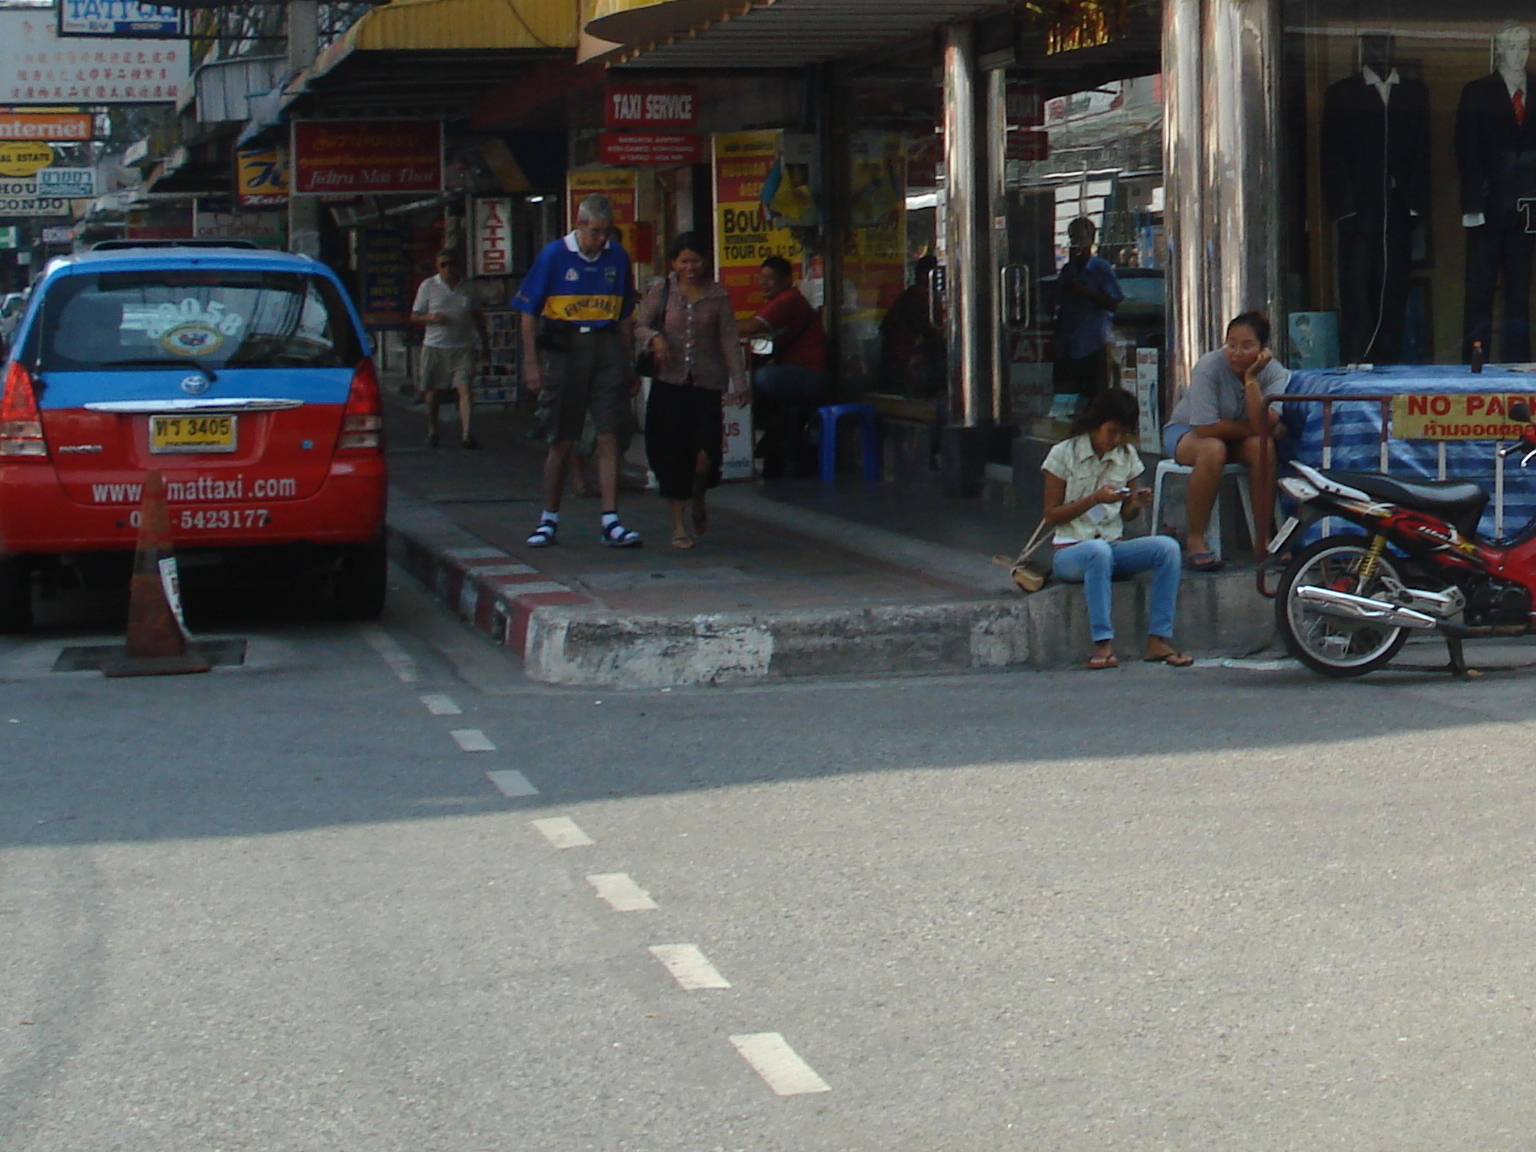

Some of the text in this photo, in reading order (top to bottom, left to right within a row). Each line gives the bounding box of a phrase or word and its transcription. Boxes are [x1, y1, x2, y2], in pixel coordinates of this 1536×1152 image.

[613, 94, 692, 119] TAXI SERVICE
[482, 201, 506, 272] TATTOO
[724, 245, 755, 260] TOUR
[1407, 395, 1451, 416] NO
[187, 417, 230, 435] 3405
